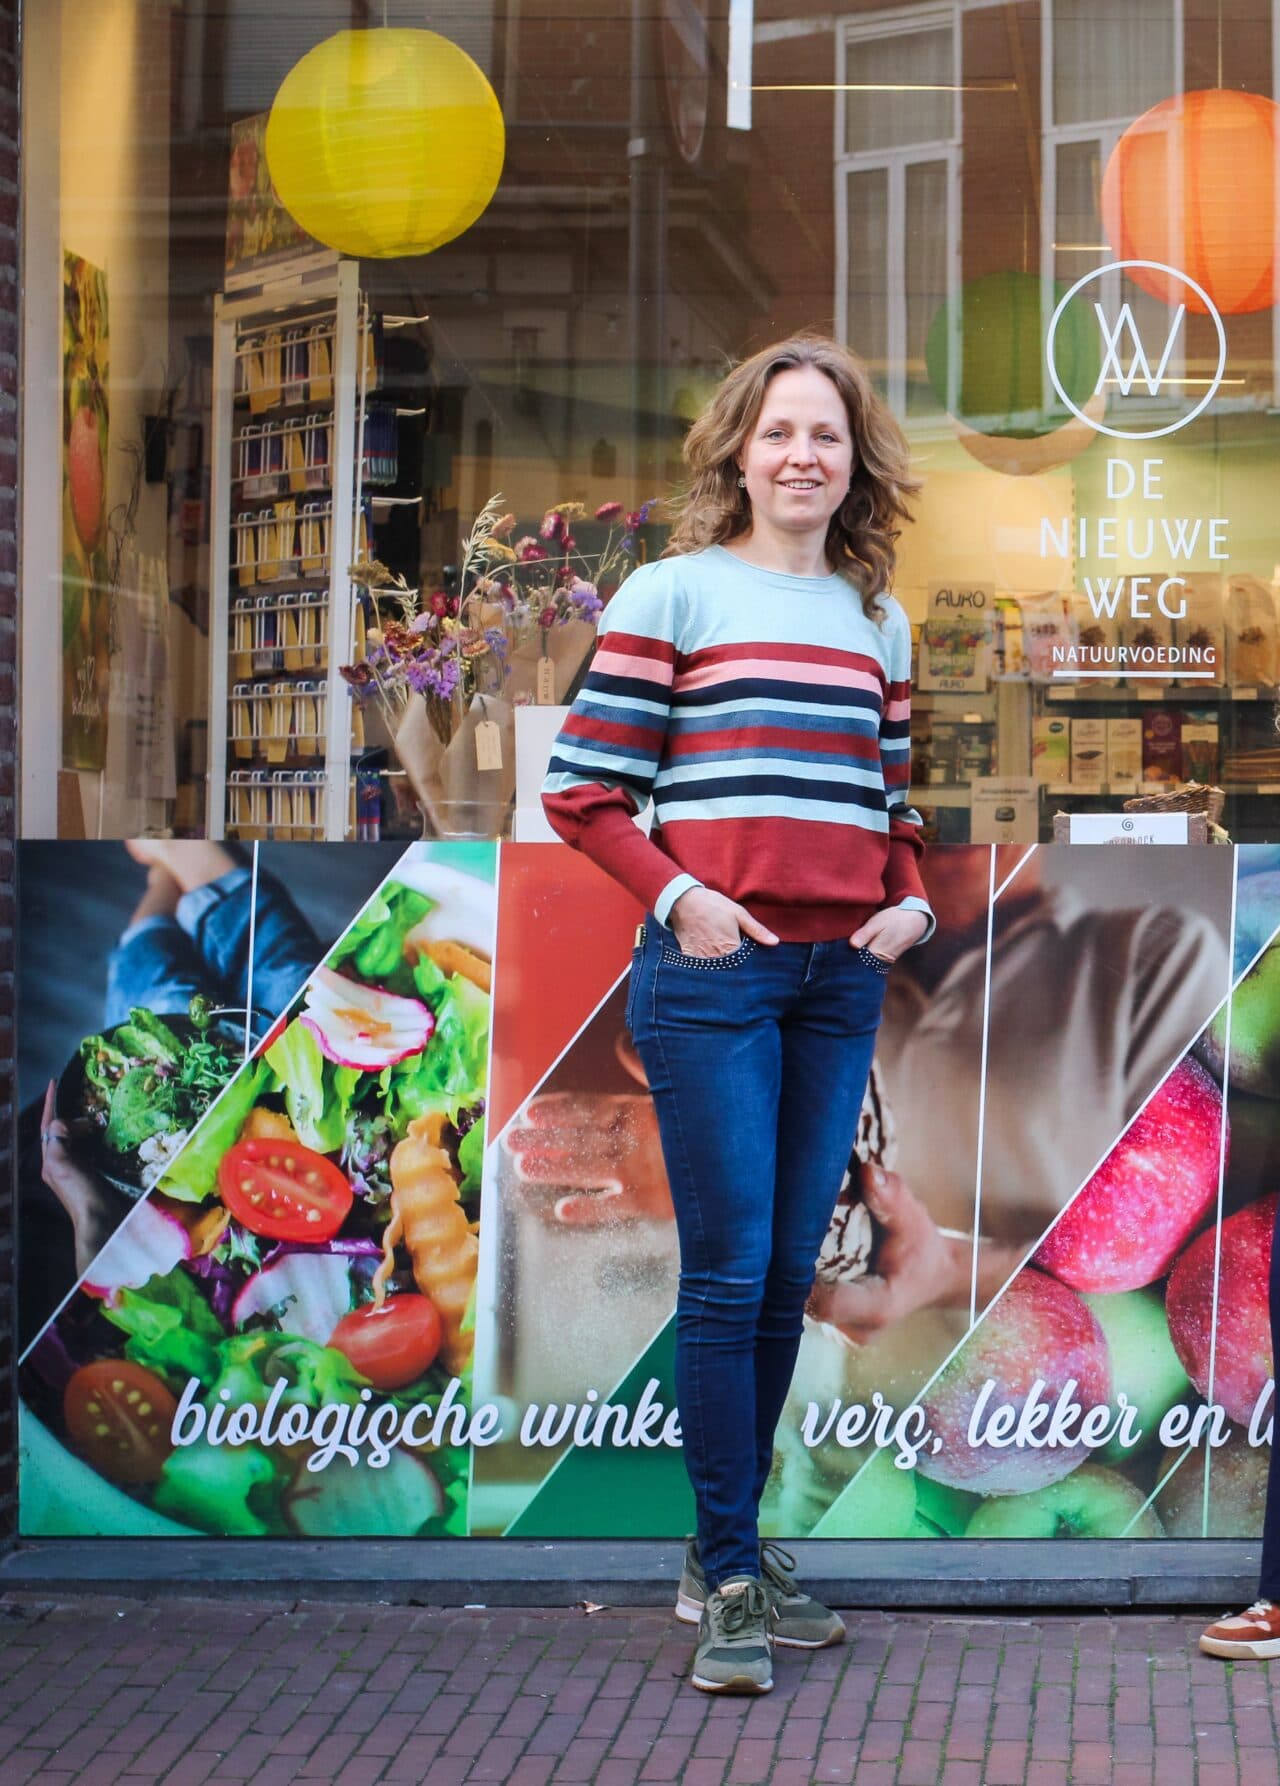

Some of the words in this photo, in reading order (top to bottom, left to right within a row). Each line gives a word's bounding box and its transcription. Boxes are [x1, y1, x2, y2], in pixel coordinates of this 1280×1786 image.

[1106, 458, 1165, 501] DE
[1040, 517, 1231, 561] NIEUWE
[1084, 577, 1188, 620] WEG
[1051, 646, 1217, 665] NATUURVOEDING
[170, 1377, 503, 1473] biologische
[519, 1377, 684, 1448] winke
[801, 1391, 943, 1471] vers,
[967, 1379, 1142, 1449] lekker
[1159, 1405, 1232, 1449] en
